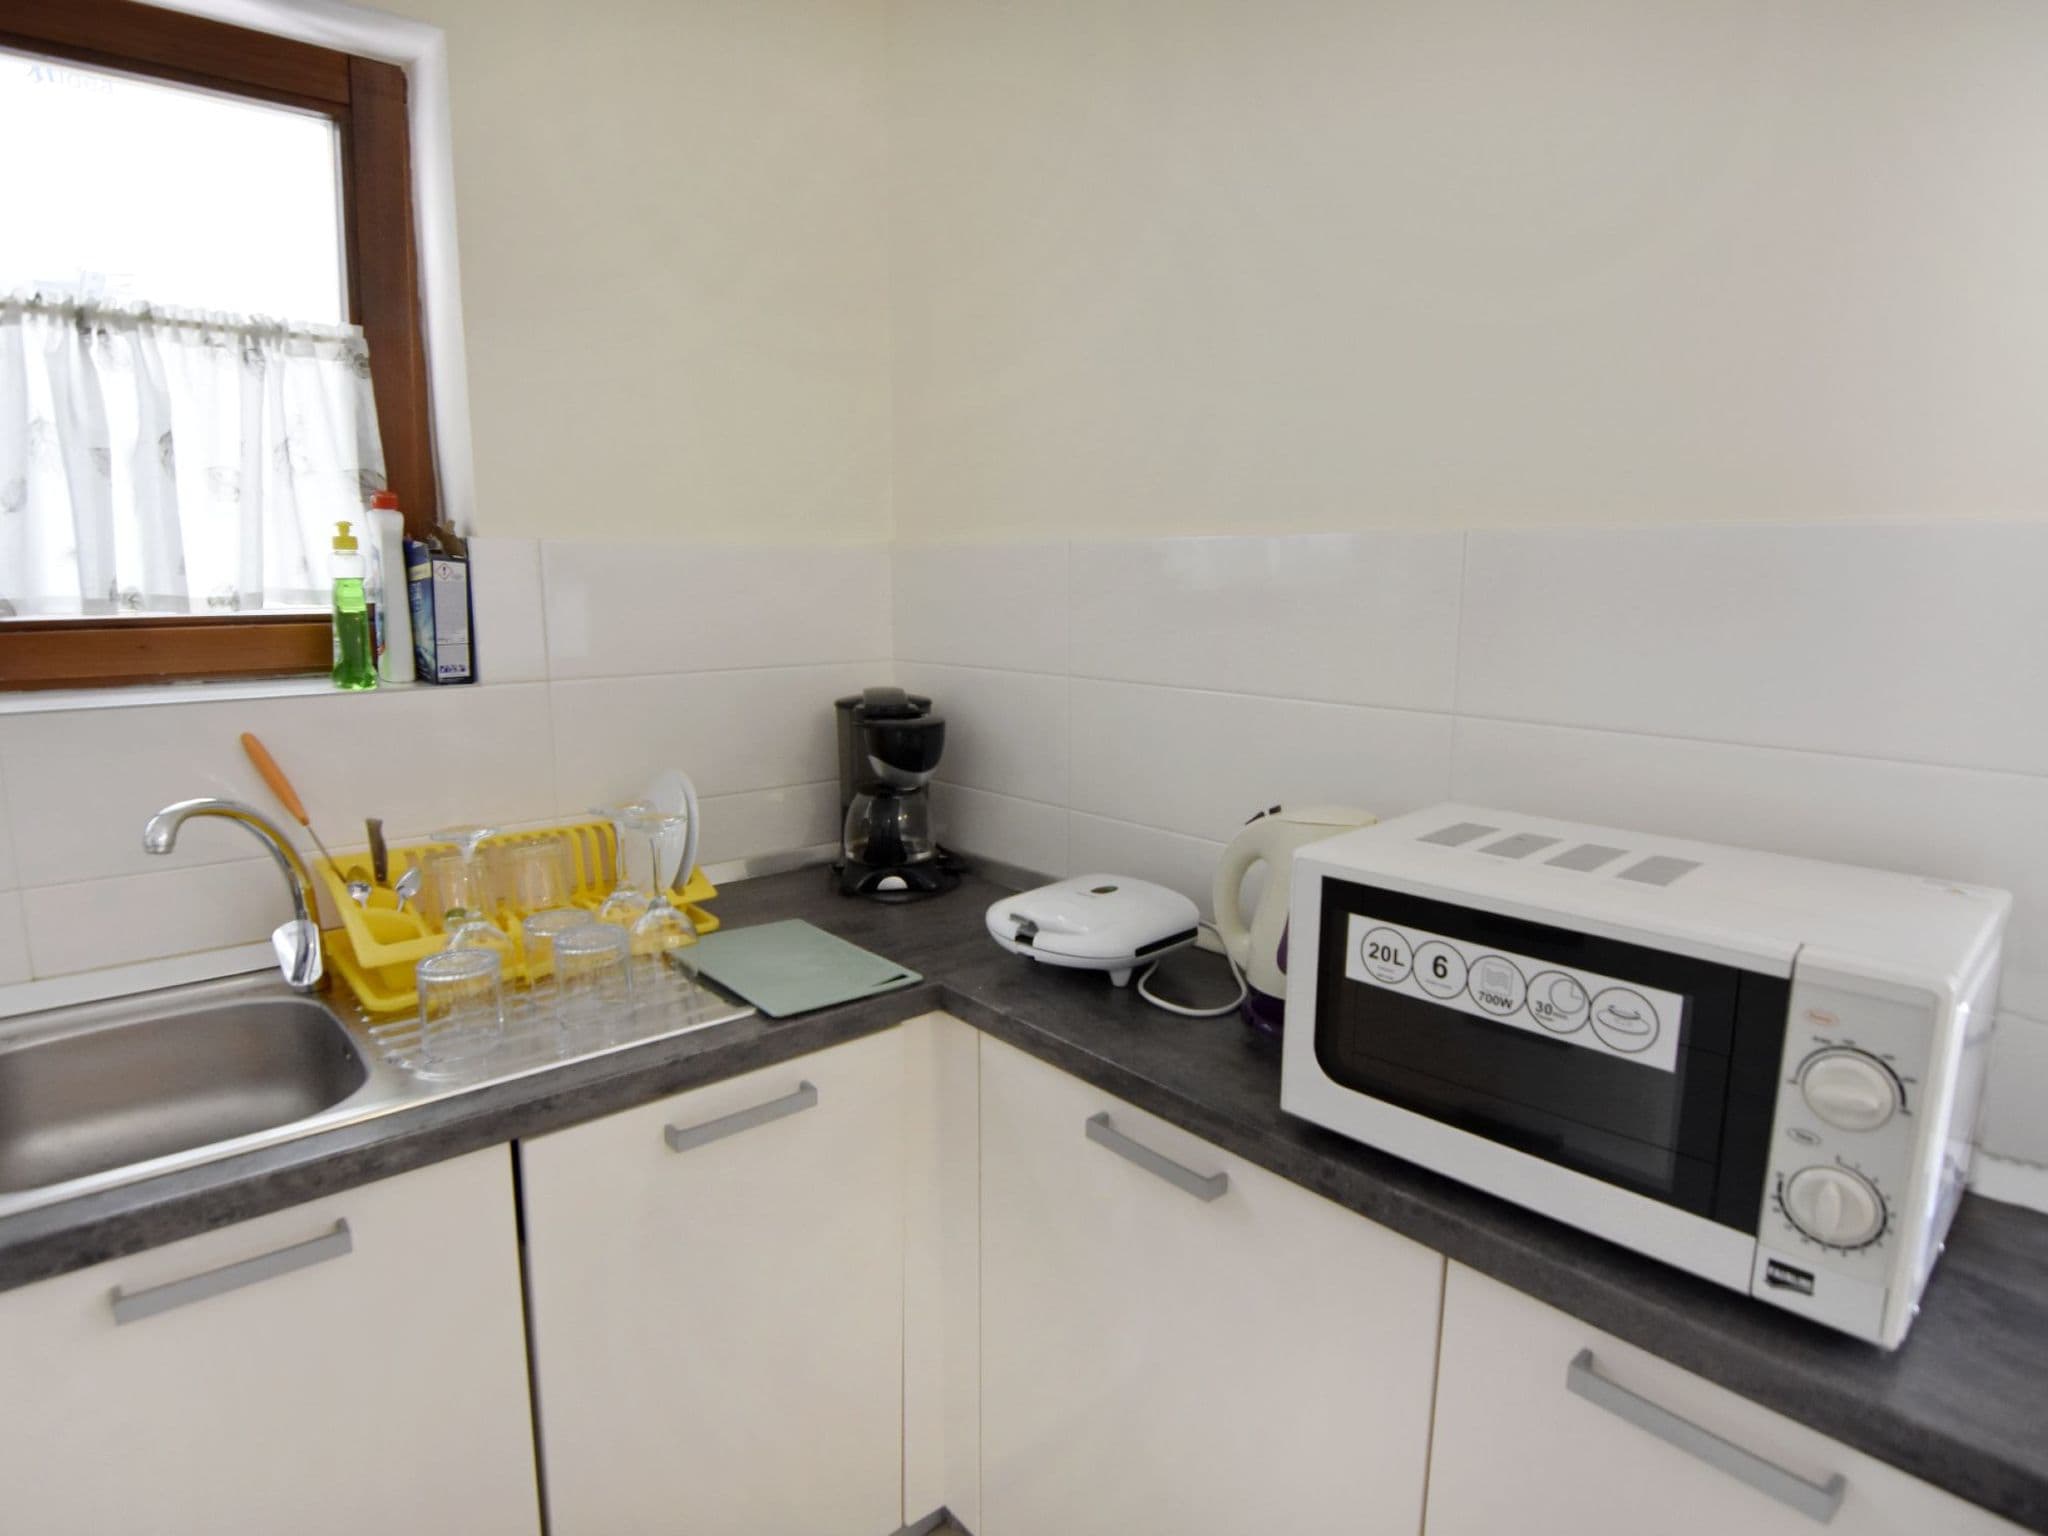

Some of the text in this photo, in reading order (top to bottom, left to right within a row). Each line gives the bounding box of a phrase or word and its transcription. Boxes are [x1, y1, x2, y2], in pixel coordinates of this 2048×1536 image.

[1368, 942, 1405, 967] 20L
[1432, 955, 1448, 979] 6
[1479, 990, 1513, 1009] 700W
